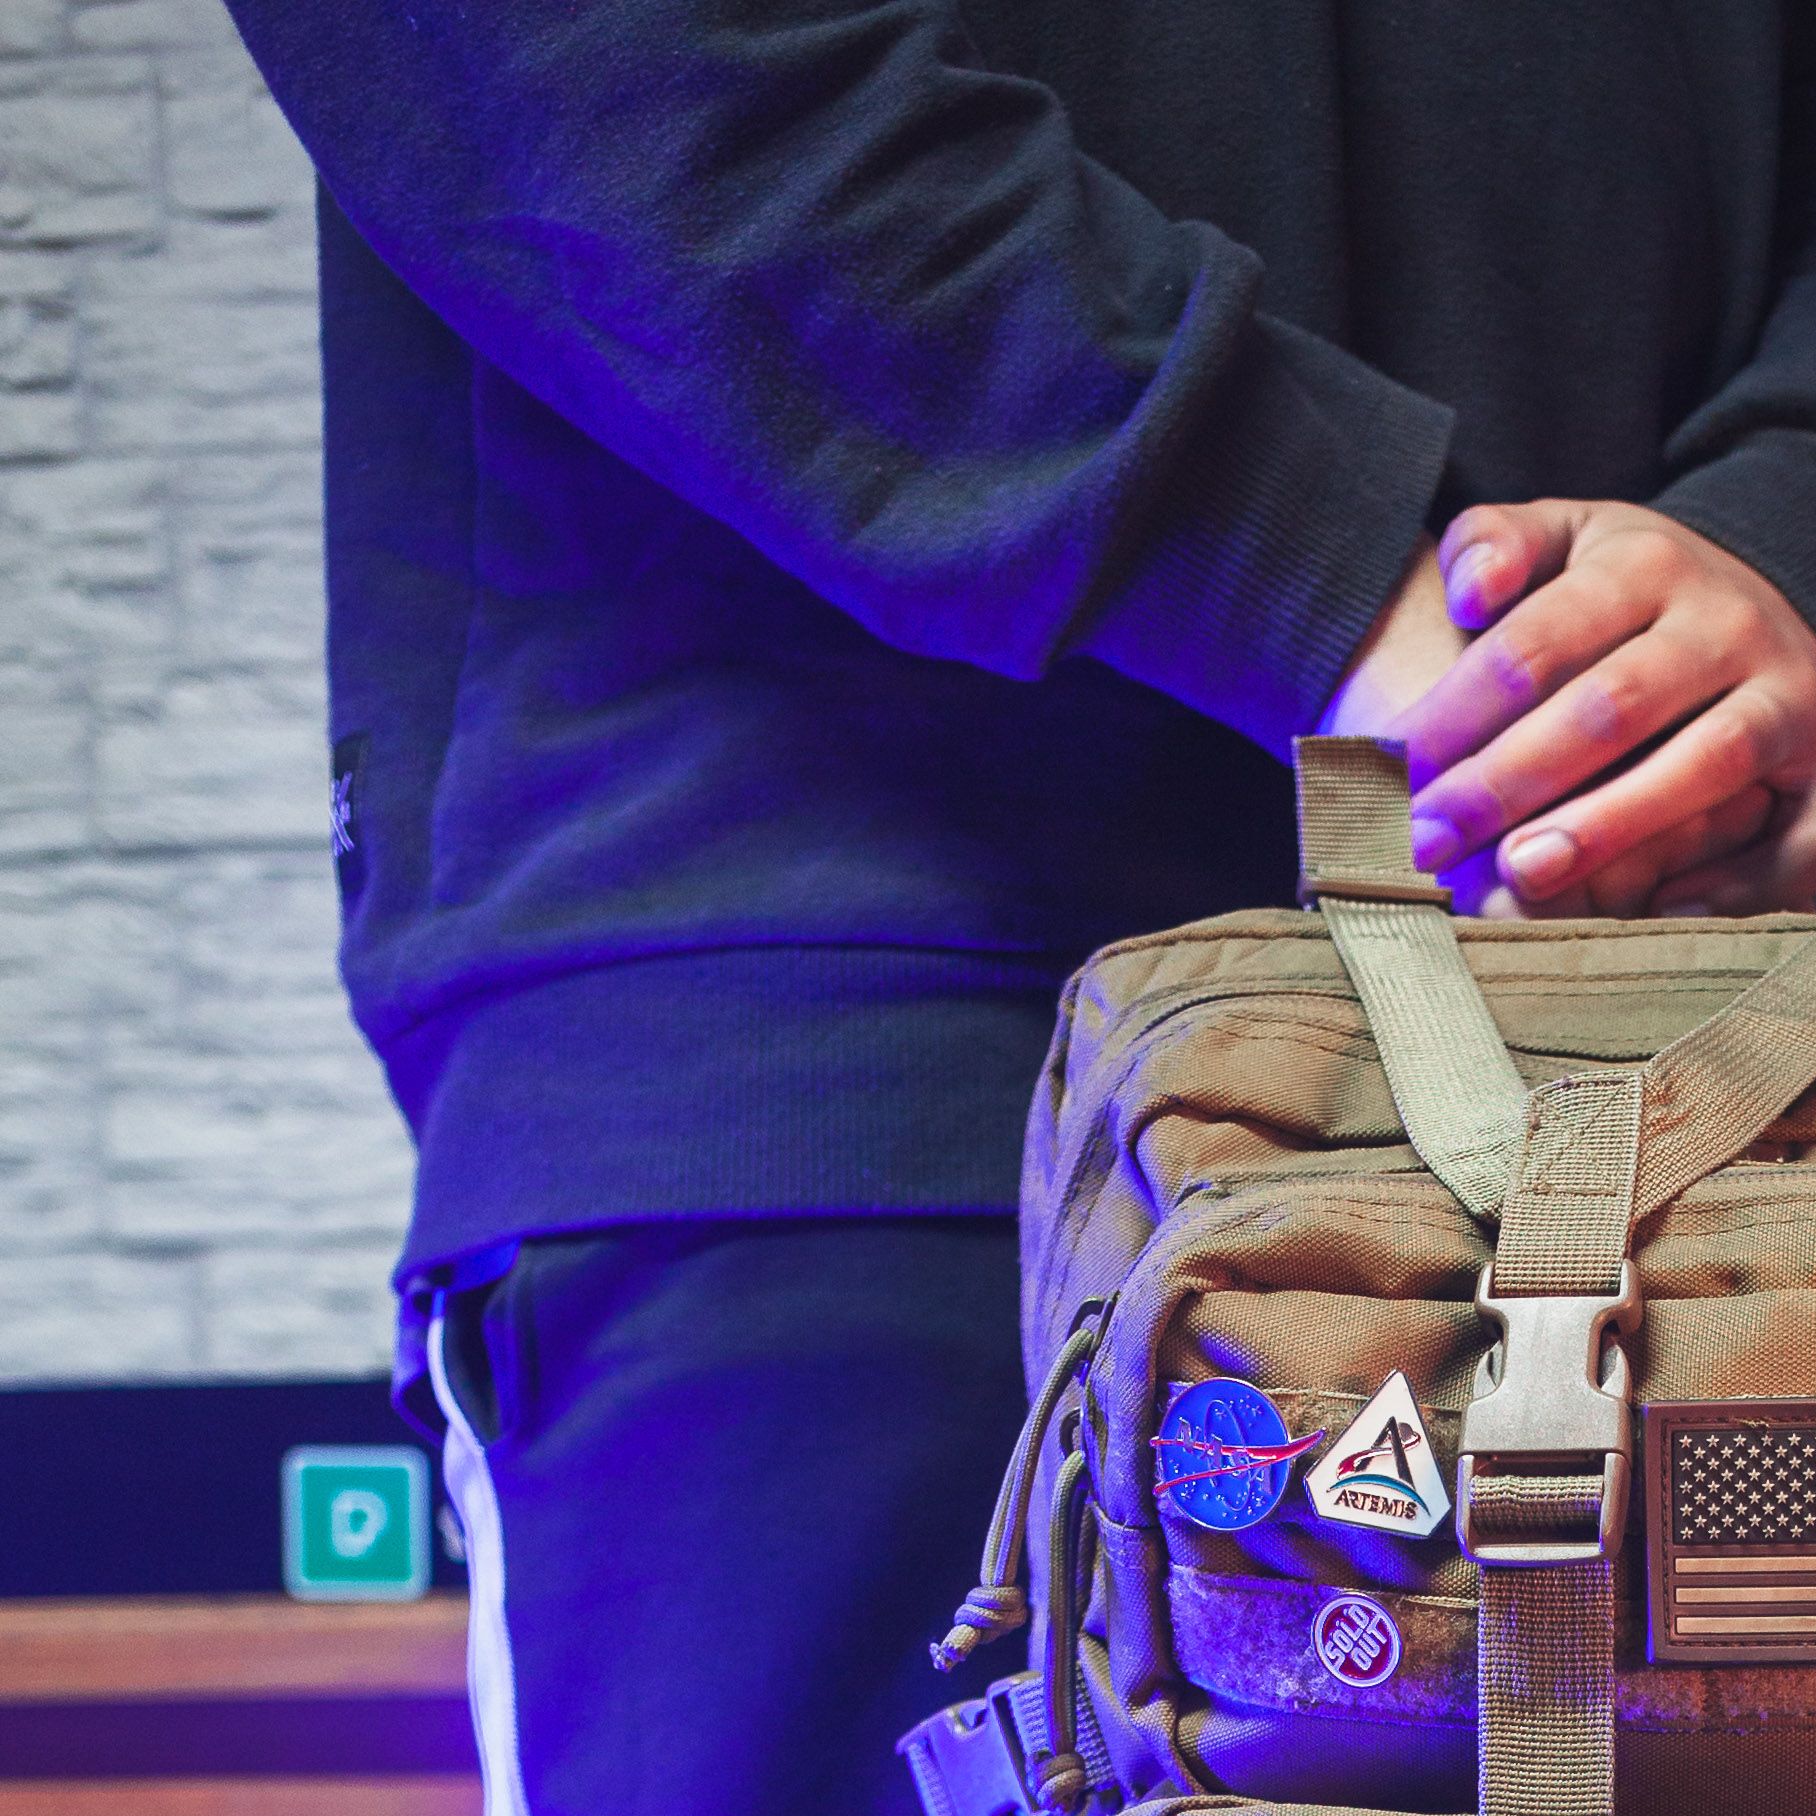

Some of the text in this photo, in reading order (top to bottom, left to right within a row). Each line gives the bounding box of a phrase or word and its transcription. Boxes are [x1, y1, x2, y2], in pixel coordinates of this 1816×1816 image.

[1334, 1489, 1418, 1521] ARTEMIS
[1325, 1604, 1370, 1668] SOLD
[1351, 1610, 1392, 1671] OUT
